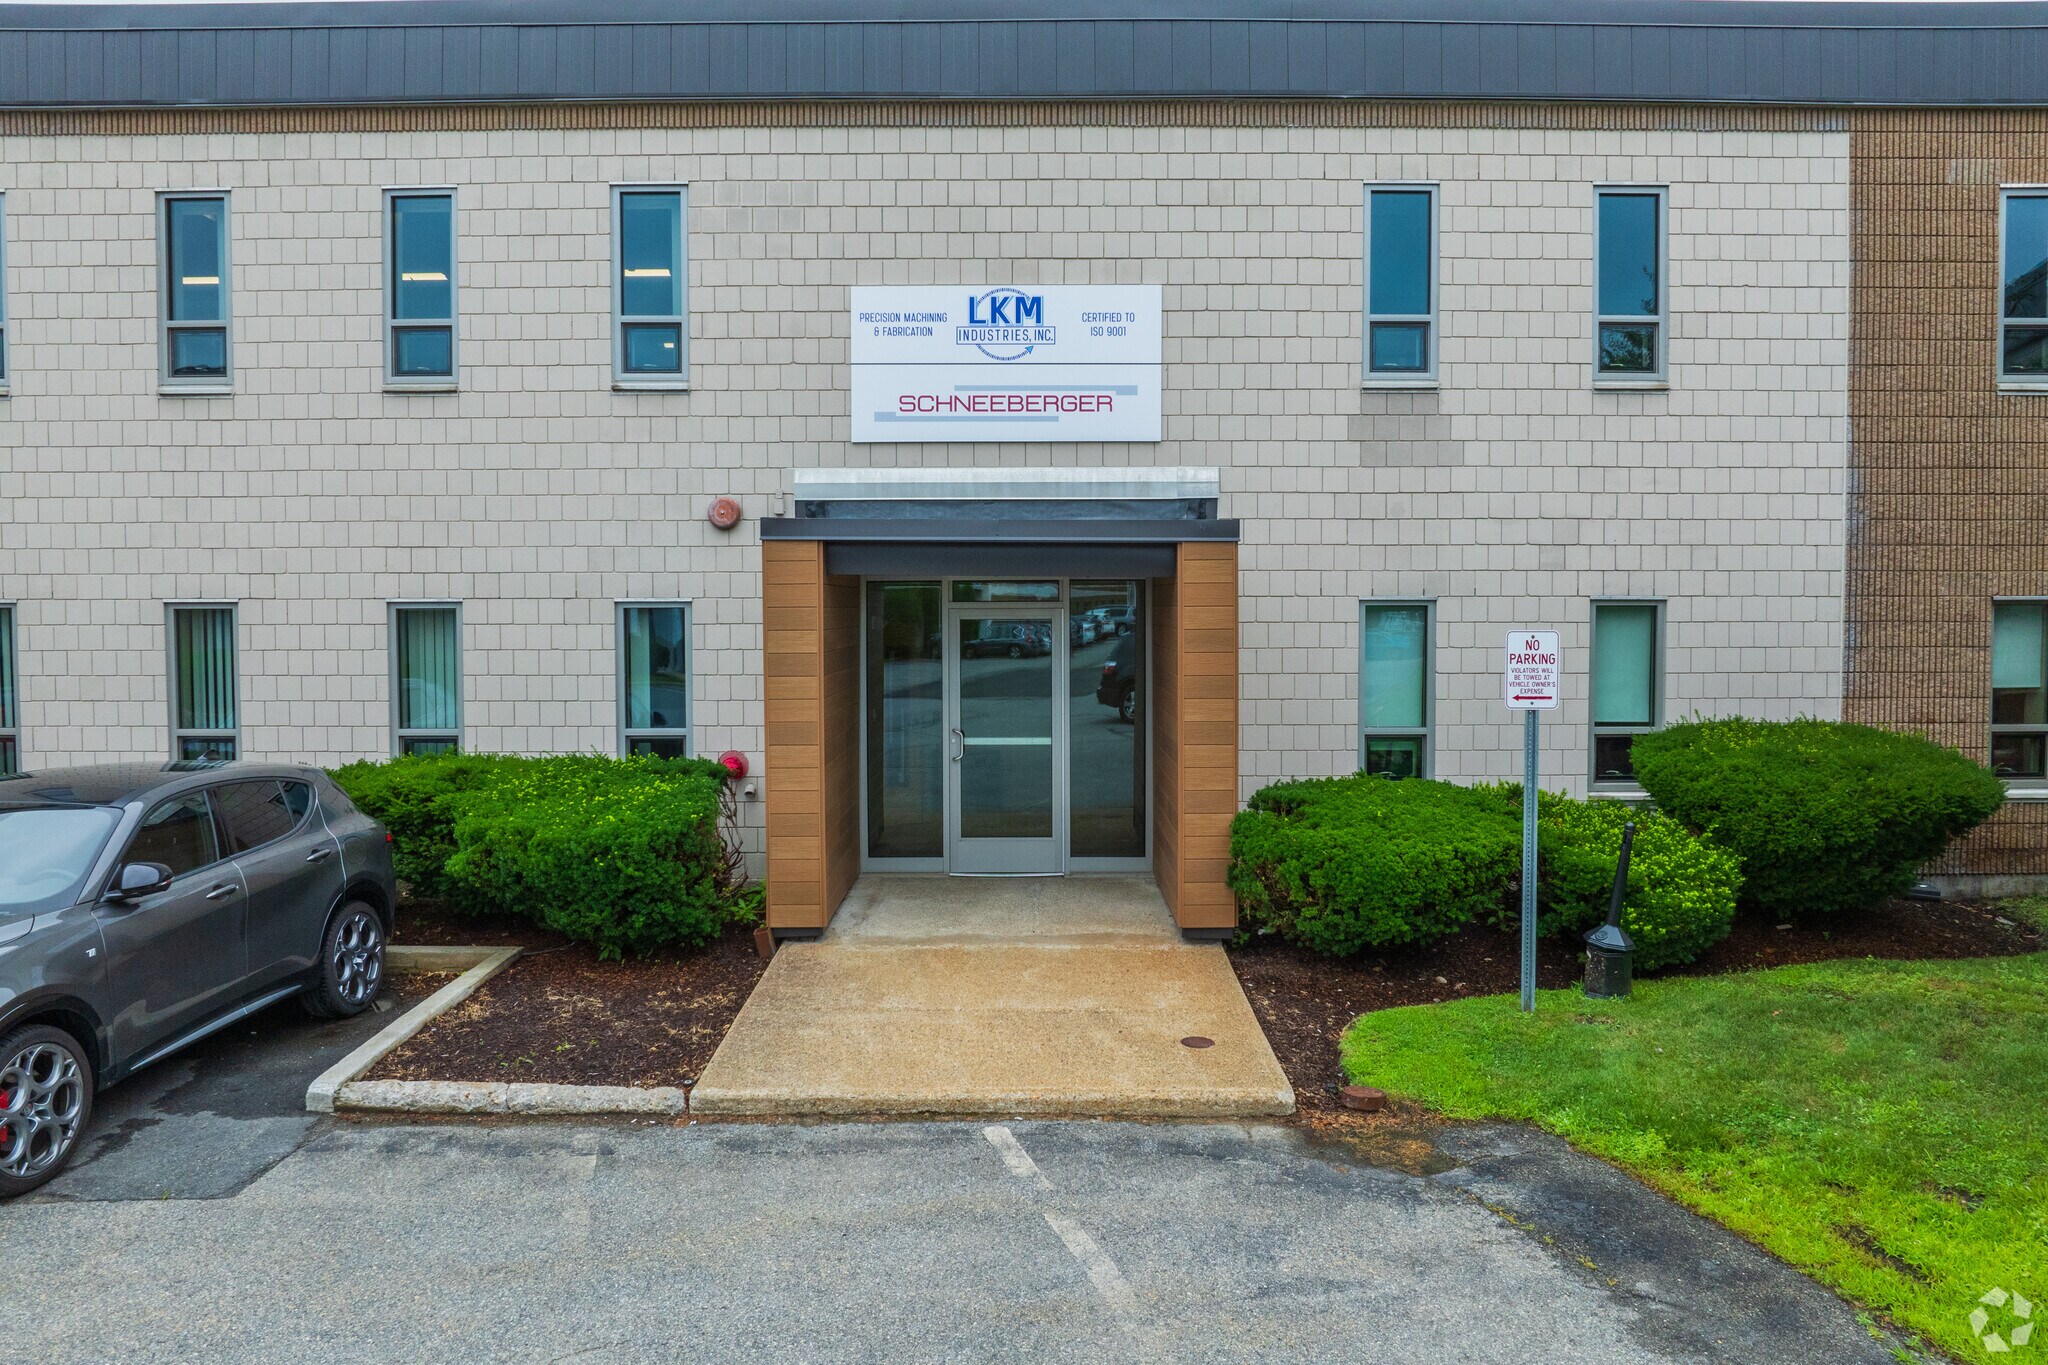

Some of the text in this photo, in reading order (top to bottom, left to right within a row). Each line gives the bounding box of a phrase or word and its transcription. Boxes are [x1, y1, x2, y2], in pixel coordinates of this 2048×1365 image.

[968, 295, 1043, 325] LKM
[859, 313, 948, 323] PRECISION MACHINING
[1081, 313, 1135, 323] CERTIFIED TO
[874, 326, 933, 337] & FABRICATION
[958, 328, 1054, 343] INDUSTRIES, INC.
[1090, 326, 1127, 337] ISO 9001
[899, 394, 1113, 413] SCHNEEBERGER
[1525, 639, 1540, 651] NO
[1509, 653, 1556, 665] PARKING
